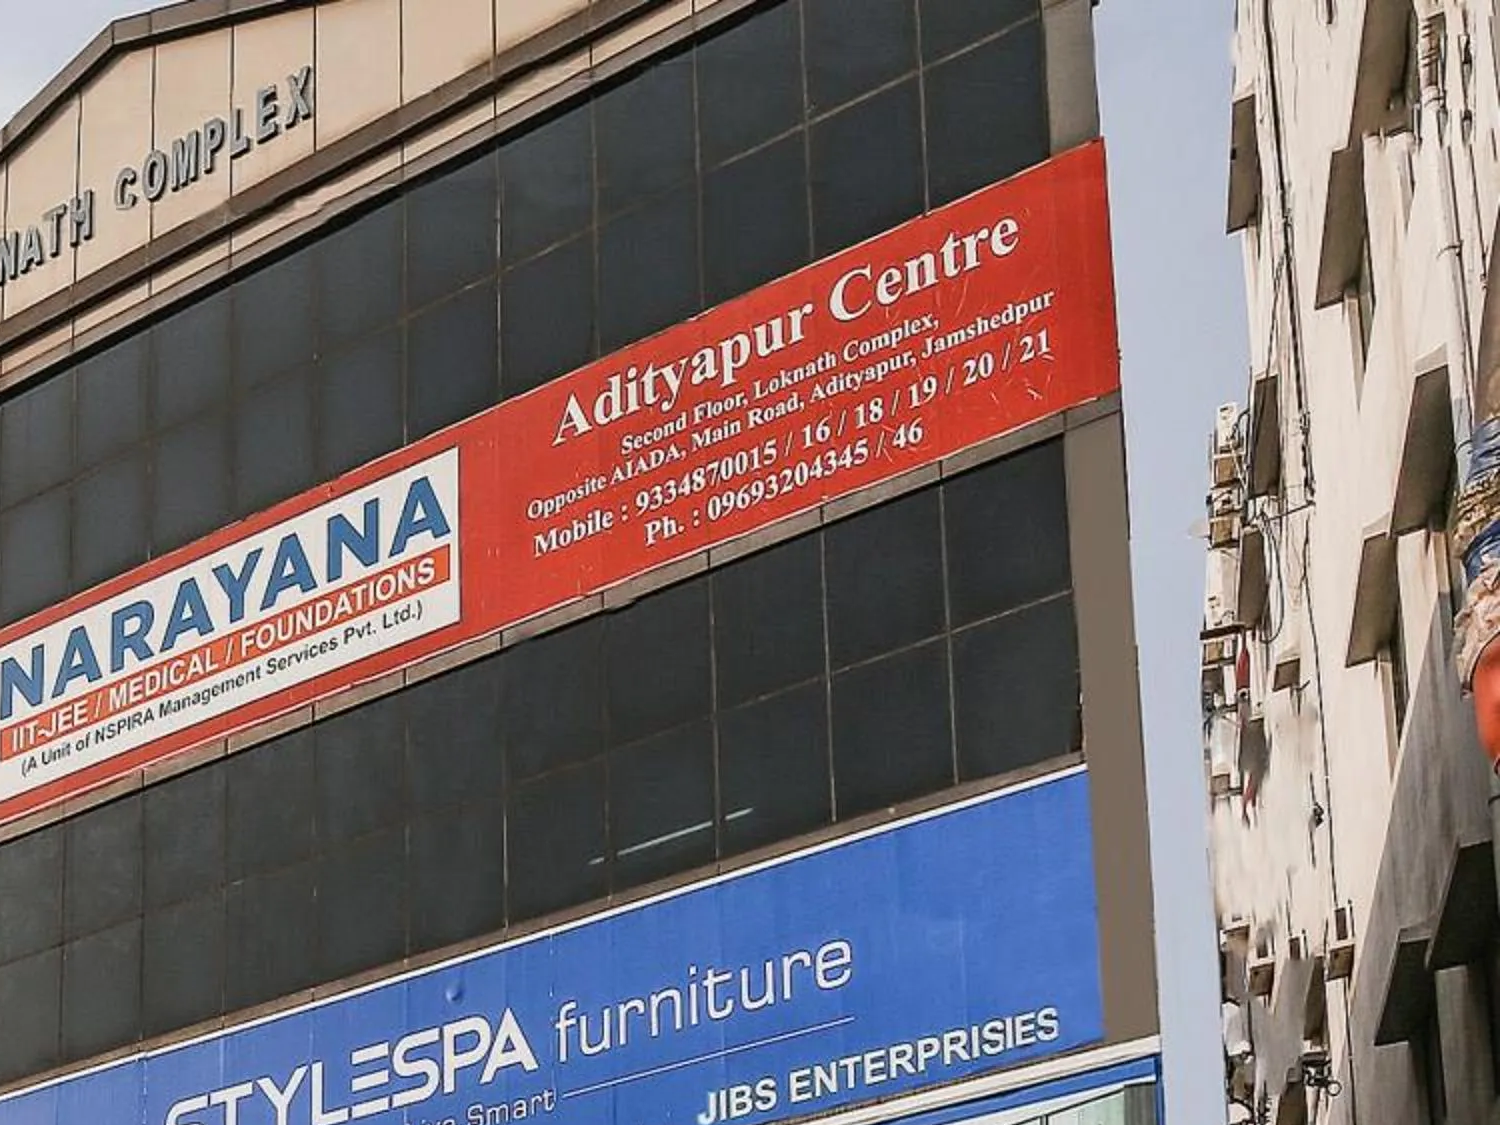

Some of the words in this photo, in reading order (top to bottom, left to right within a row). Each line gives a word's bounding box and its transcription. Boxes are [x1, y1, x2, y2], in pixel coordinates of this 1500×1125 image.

[114, 64, 314, 211] COMPLEX
[527, 474, 607, 519] Opposite
[691, 420, 741, 452] Main
[747, 392, 804, 428] Road,
[810, 353, 917, 402] Adityapur,
[922, 291, 1055, 358] Jamshedpur
[551, 302, 813, 446] Adityapur
[830, 215, 1020, 323] Centre
[621, 413, 688, 455] Second
[694, 392, 748, 425] Floor,
[753, 352, 838, 400] Loknath
[843, 312, 939, 363] Complex,
[533, 510, 614, 558] Mobile
[635, 439, 778, 516] 9334870015
[802, 416, 831, 448] 16
[855, 398, 883, 429] 18
[908, 376, 937, 409] 19
[962, 352, 994, 386] 20
[1019, 328, 1051, 363] 21
[645, 516, 685, 546] Ph.
[708, 438, 869, 521] 09693204345
[892, 416, 923, 449] 46
[0, 476, 451, 721] NARAYANA
[11, 701, 90, 752] IIT-JEE
[109, 653, 219, 708] MEDICAL
[241, 558, 435, 659] FOUNDATIONS
[21, 755, 39, 777] (A
[41, 741, 71, 766] Unit
[75, 731, 90, 752] of
[95, 707, 154, 746] NSPIRA
[159, 665, 261, 718] Management
[267, 638, 338, 676] Services
[343, 622, 377, 646] Pvt.
[383, 600, 423, 630] Ltd.)
[555, 937, 854, 1063] furniture
[788, 1006, 1060, 1103] ENTERPRISIES
